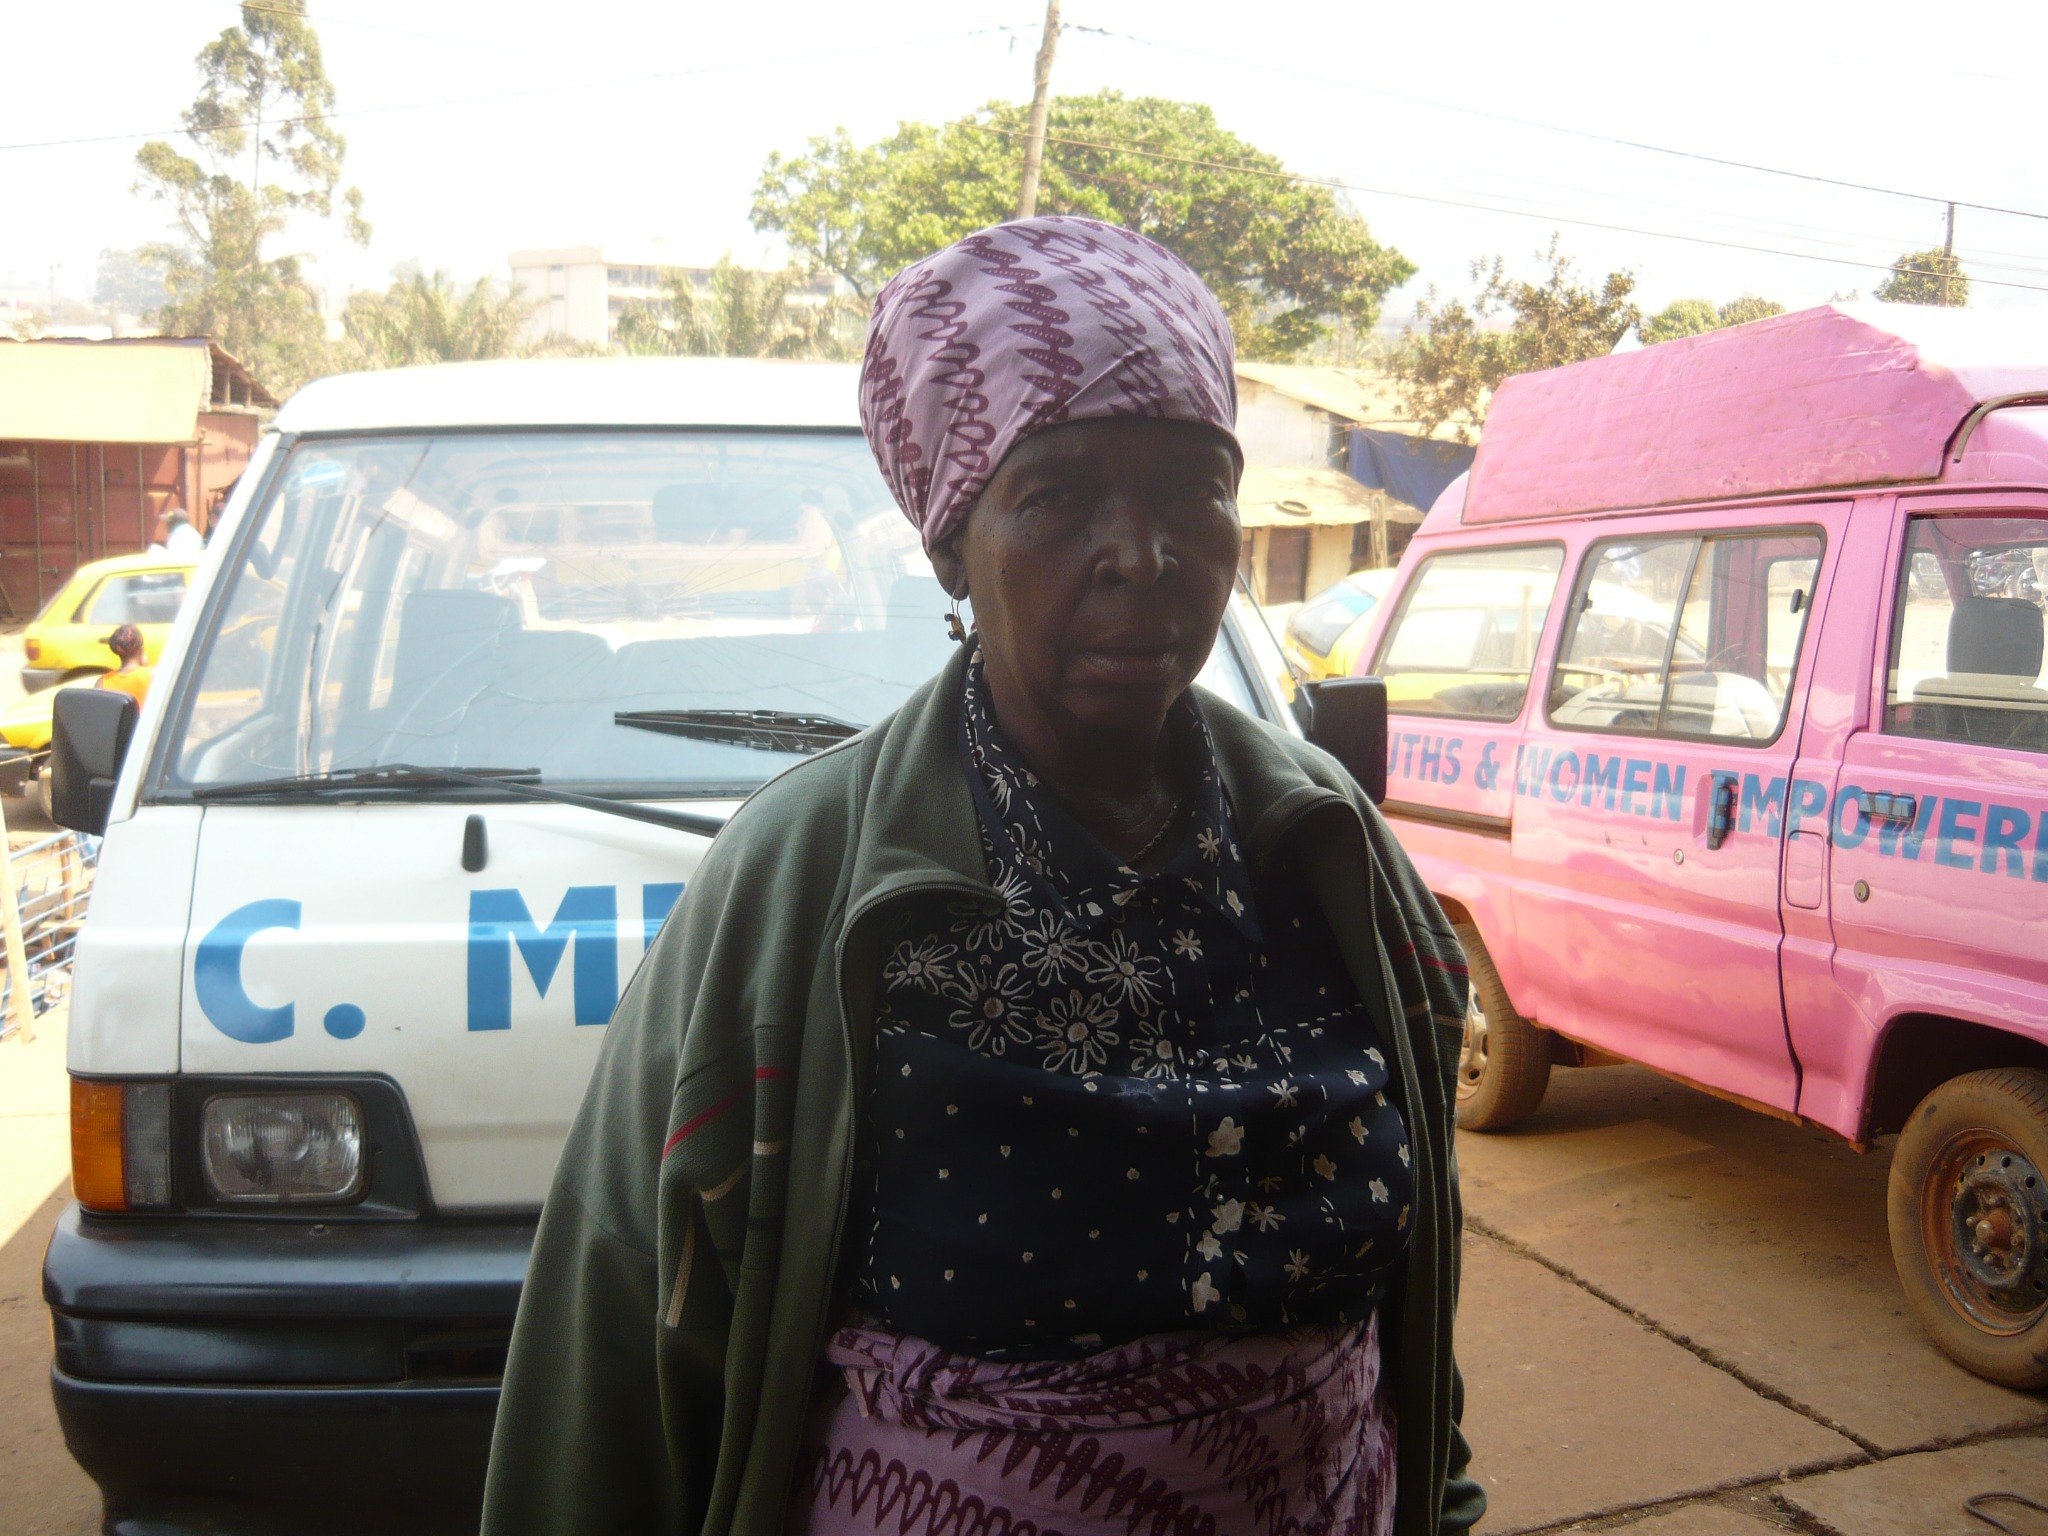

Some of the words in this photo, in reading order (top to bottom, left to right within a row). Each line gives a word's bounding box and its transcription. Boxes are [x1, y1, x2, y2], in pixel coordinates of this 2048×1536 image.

[1474, 741, 1500, 791] &
[1516, 744, 1687, 822] WOMEN
[194, 898, 366, 1044] C.
